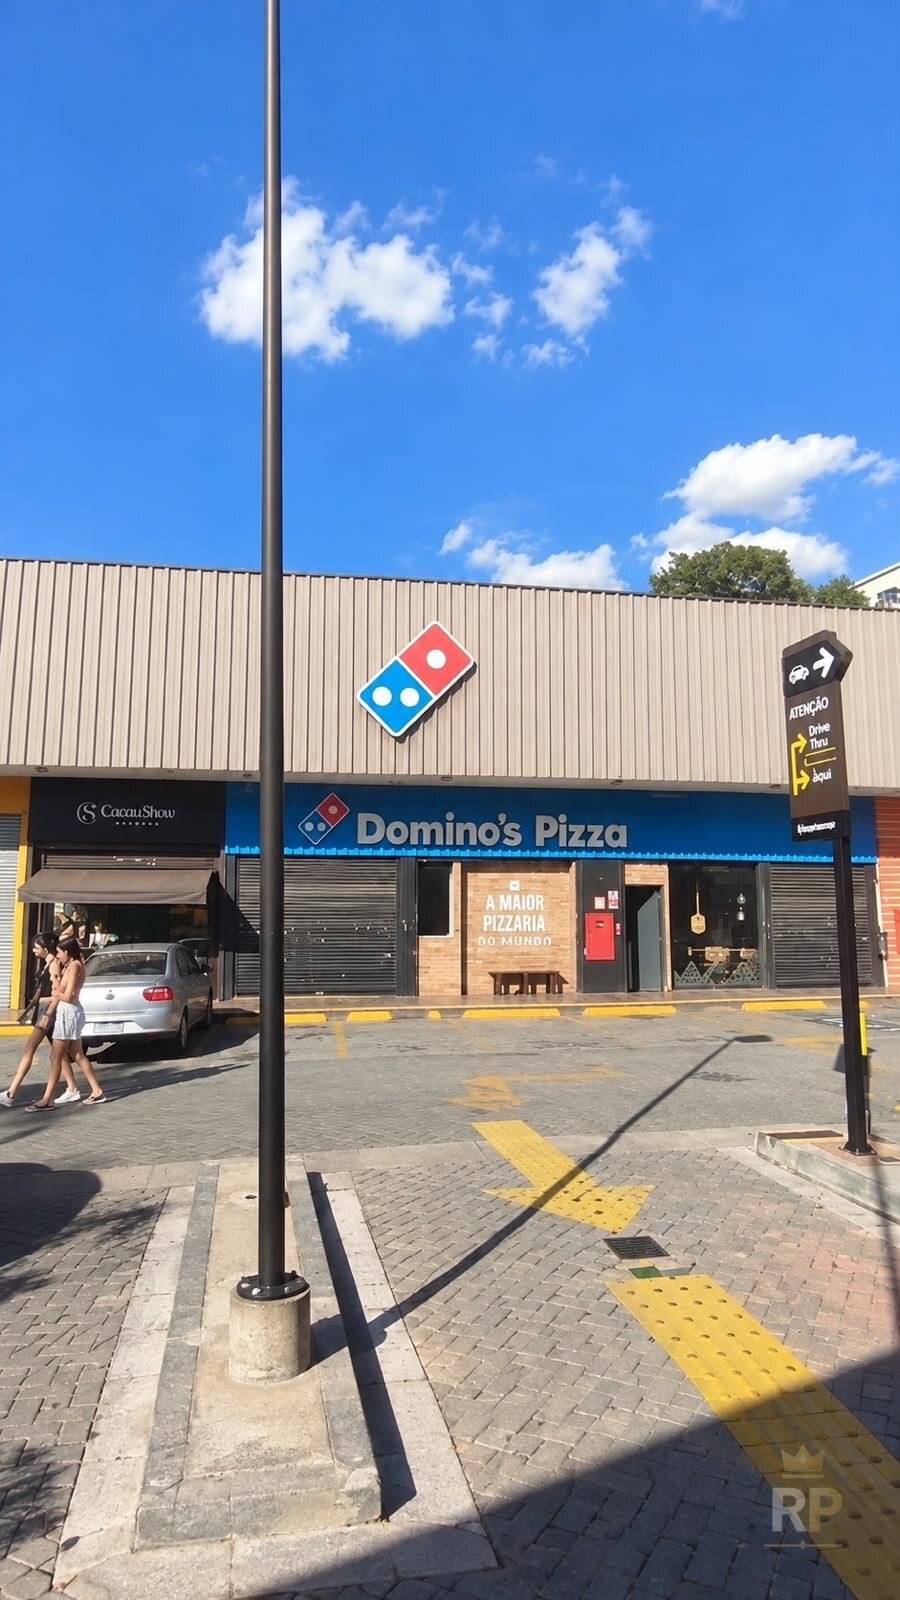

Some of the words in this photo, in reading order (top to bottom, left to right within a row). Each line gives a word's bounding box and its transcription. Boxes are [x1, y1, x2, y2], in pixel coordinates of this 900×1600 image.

[789, 696, 829, 720] ATENÇÃO
[808, 723, 831, 737] Drive
[809, 737, 829, 750] Thru
[357, 811, 522, 847] Domino's
[535, 813, 628, 848] Pizza
[485, 894, 496, 911] A
[500, 894, 545, 911] MAIOR
[483, 914, 546, 932] PIZZARIA
[478, 936, 496, 946] DO
[501, 936, 552, 946] MUNDO
